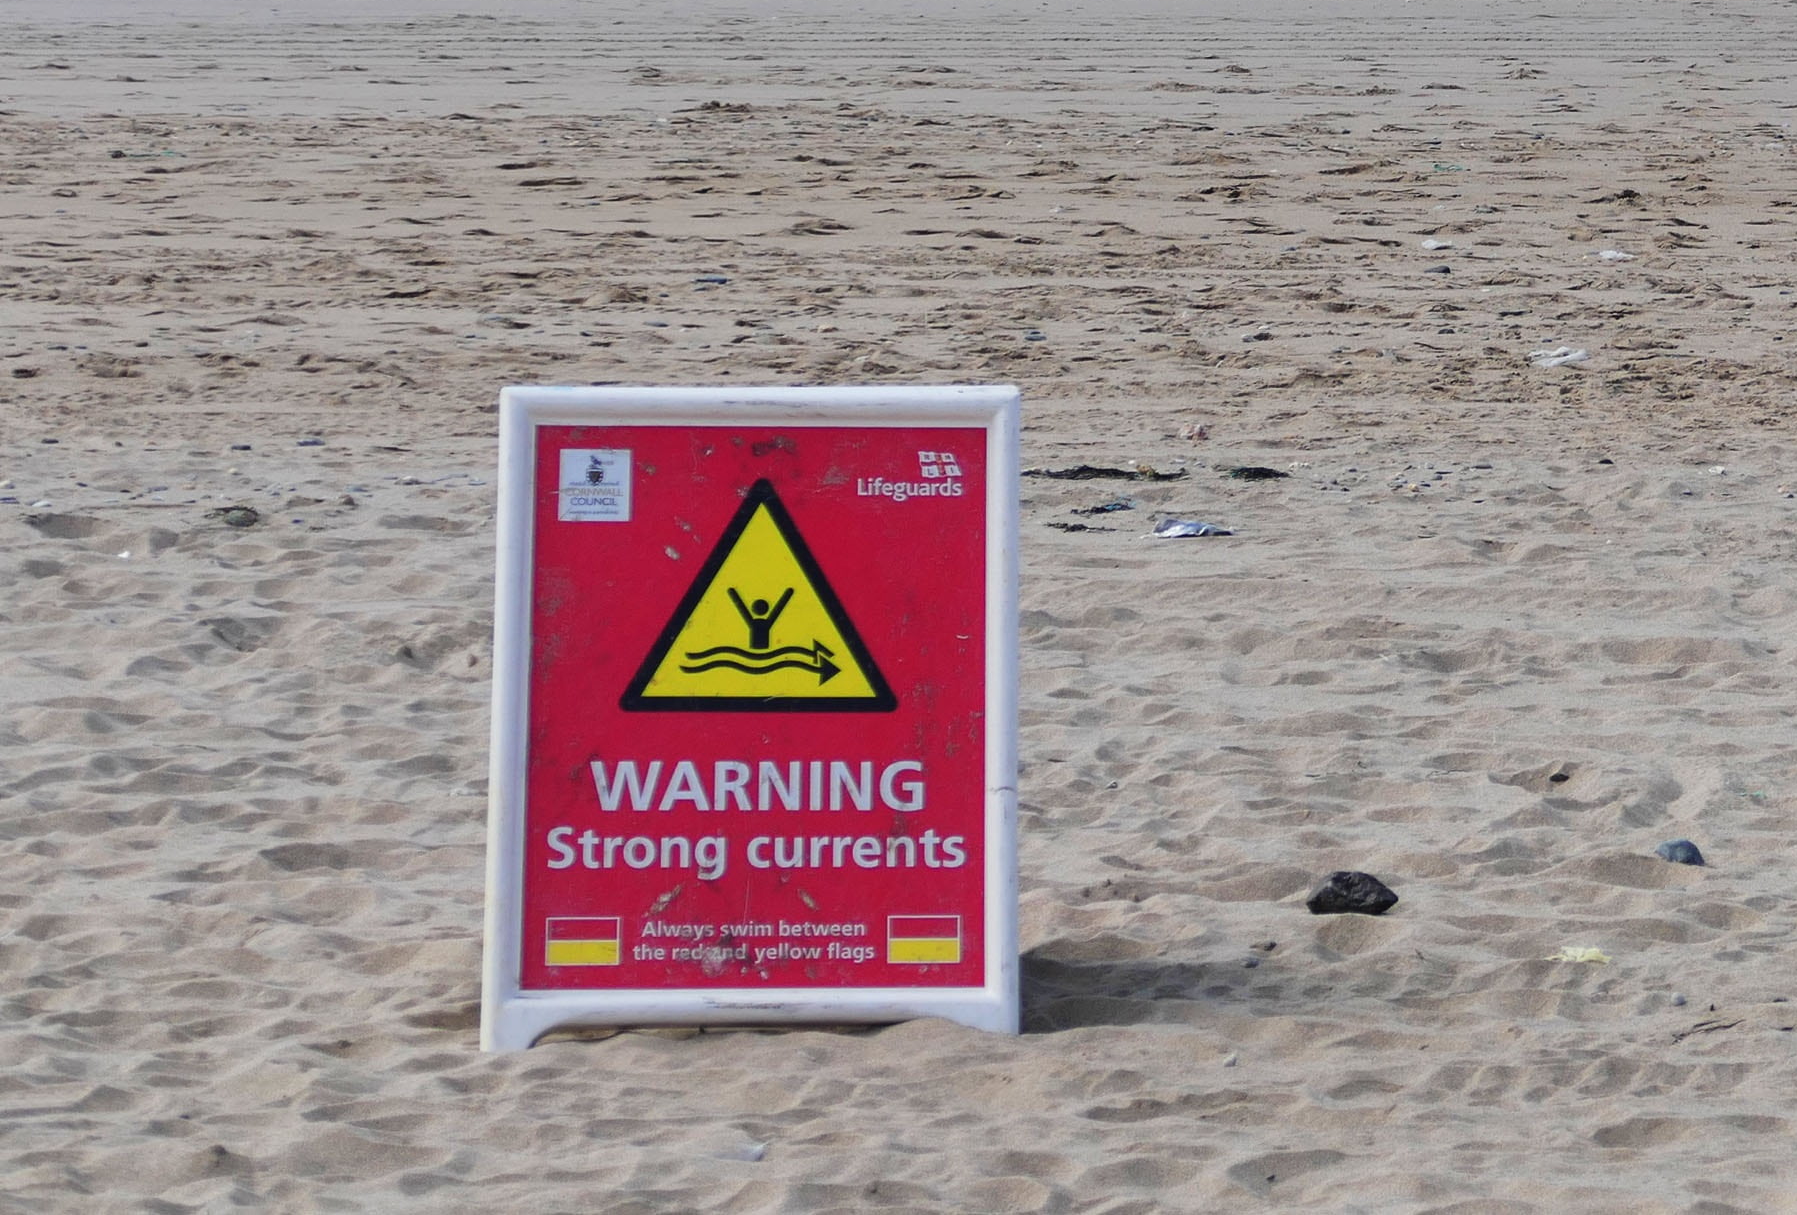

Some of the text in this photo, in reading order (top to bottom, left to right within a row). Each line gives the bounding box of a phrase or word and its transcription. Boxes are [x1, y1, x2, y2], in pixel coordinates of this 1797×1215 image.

[857, 477, 962, 501] Lifeguards
[570, 497, 617, 505] COUNCIL
[590, 761, 925, 812] WARNING
[546, 826, 966, 880] Strong currents
[641, 920, 866, 941] Always swim between
[632, 945, 665, 960] the
[671, 944, 702, 960] red
[754, 943, 821, 963] yellow
[828, 943, 875, 963] flags
